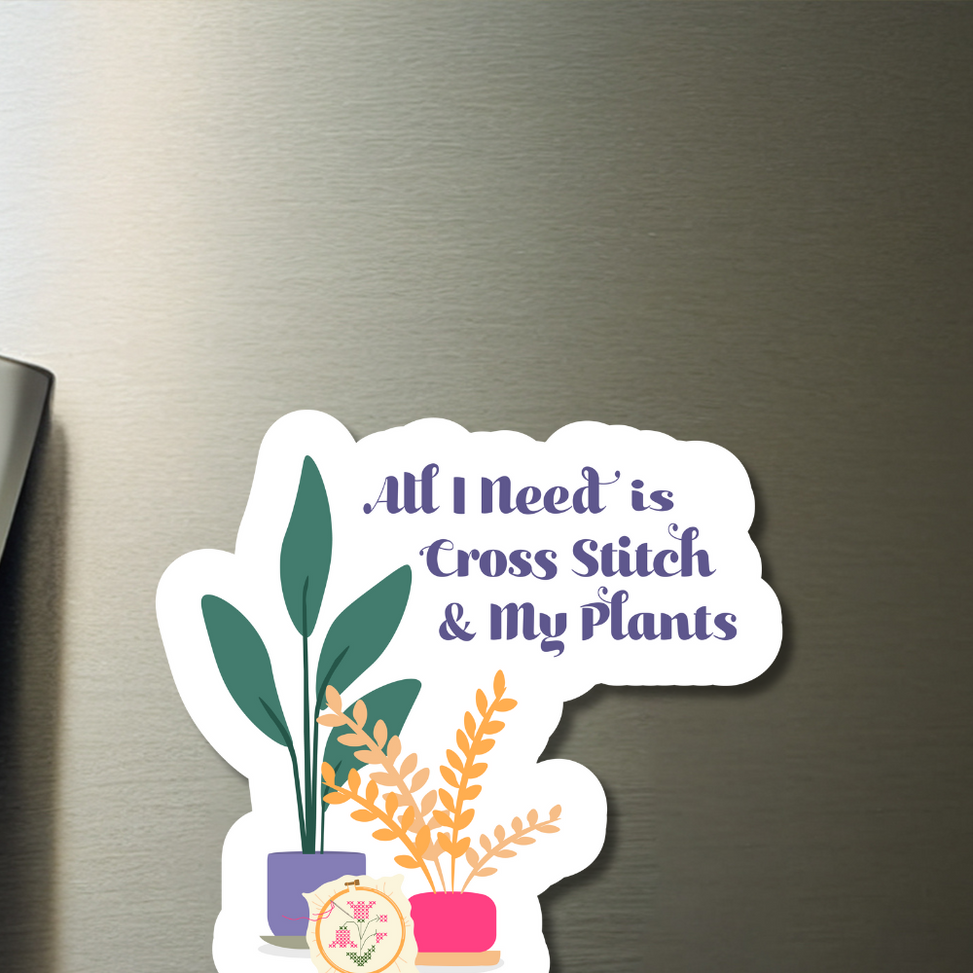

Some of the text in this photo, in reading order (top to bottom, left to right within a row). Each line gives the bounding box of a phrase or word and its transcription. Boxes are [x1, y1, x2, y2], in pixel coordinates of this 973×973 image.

[363, 463, 674, 514] All I Need is
[419, 523, 716, 580] Cross Stitch
[439, 586, 737, 657] & My Plants
